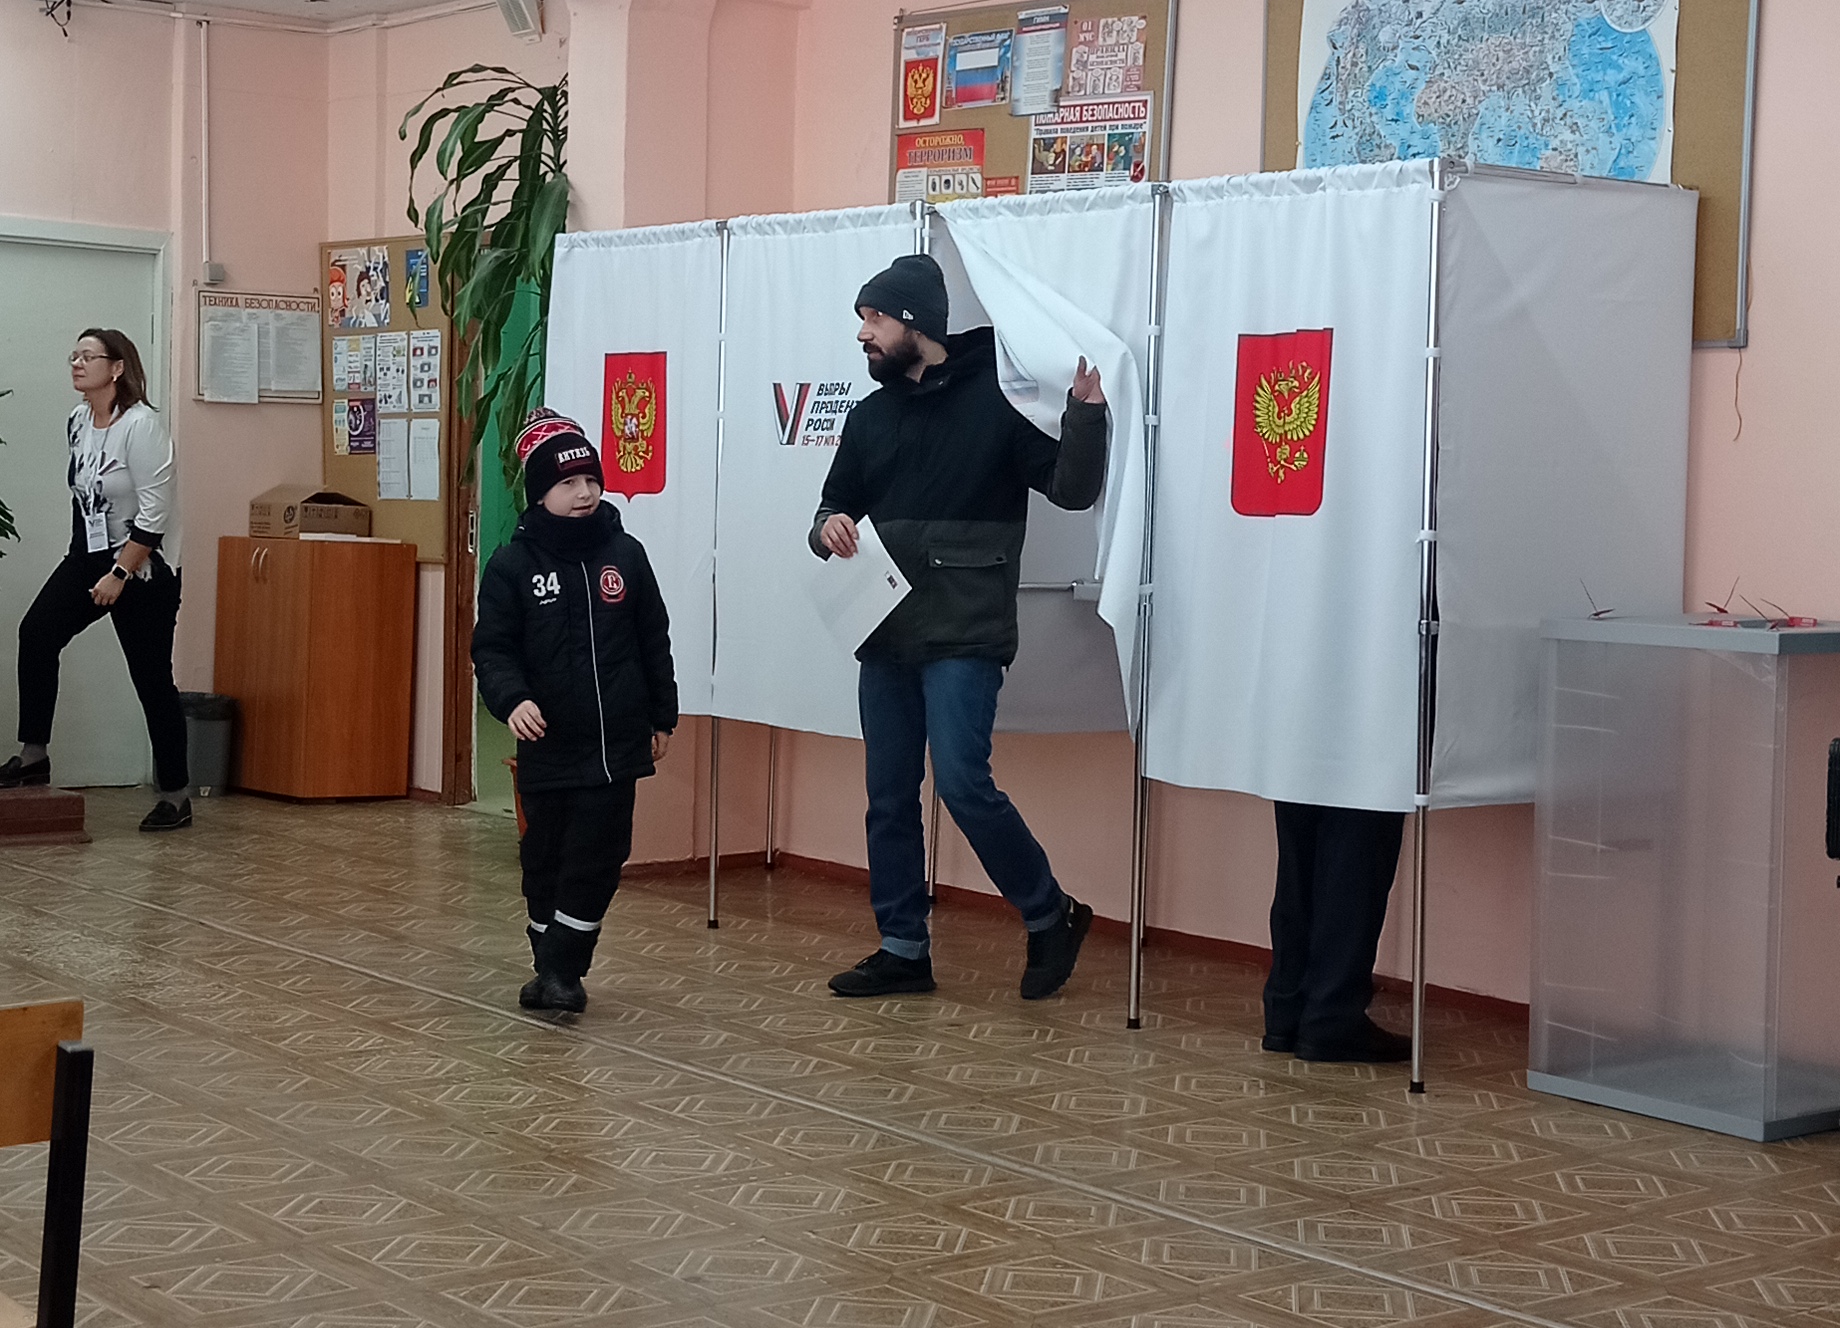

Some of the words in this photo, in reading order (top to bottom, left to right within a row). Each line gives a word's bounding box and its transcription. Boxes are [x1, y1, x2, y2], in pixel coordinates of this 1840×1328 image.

[1082, 102, 1146, 121] БЕЗОПАСНОСТЬ
[915, 134, 965, 147] ОСТОРОЖНО,
[907, 146, 974, 166] ТЕРРОРИЗМ
[202, 295, 240, 307] ТЕХНИКА
[244, 297, 316, 311] БЕЗОПАСНОСТИ
[532, 572, 561, 597] 34
